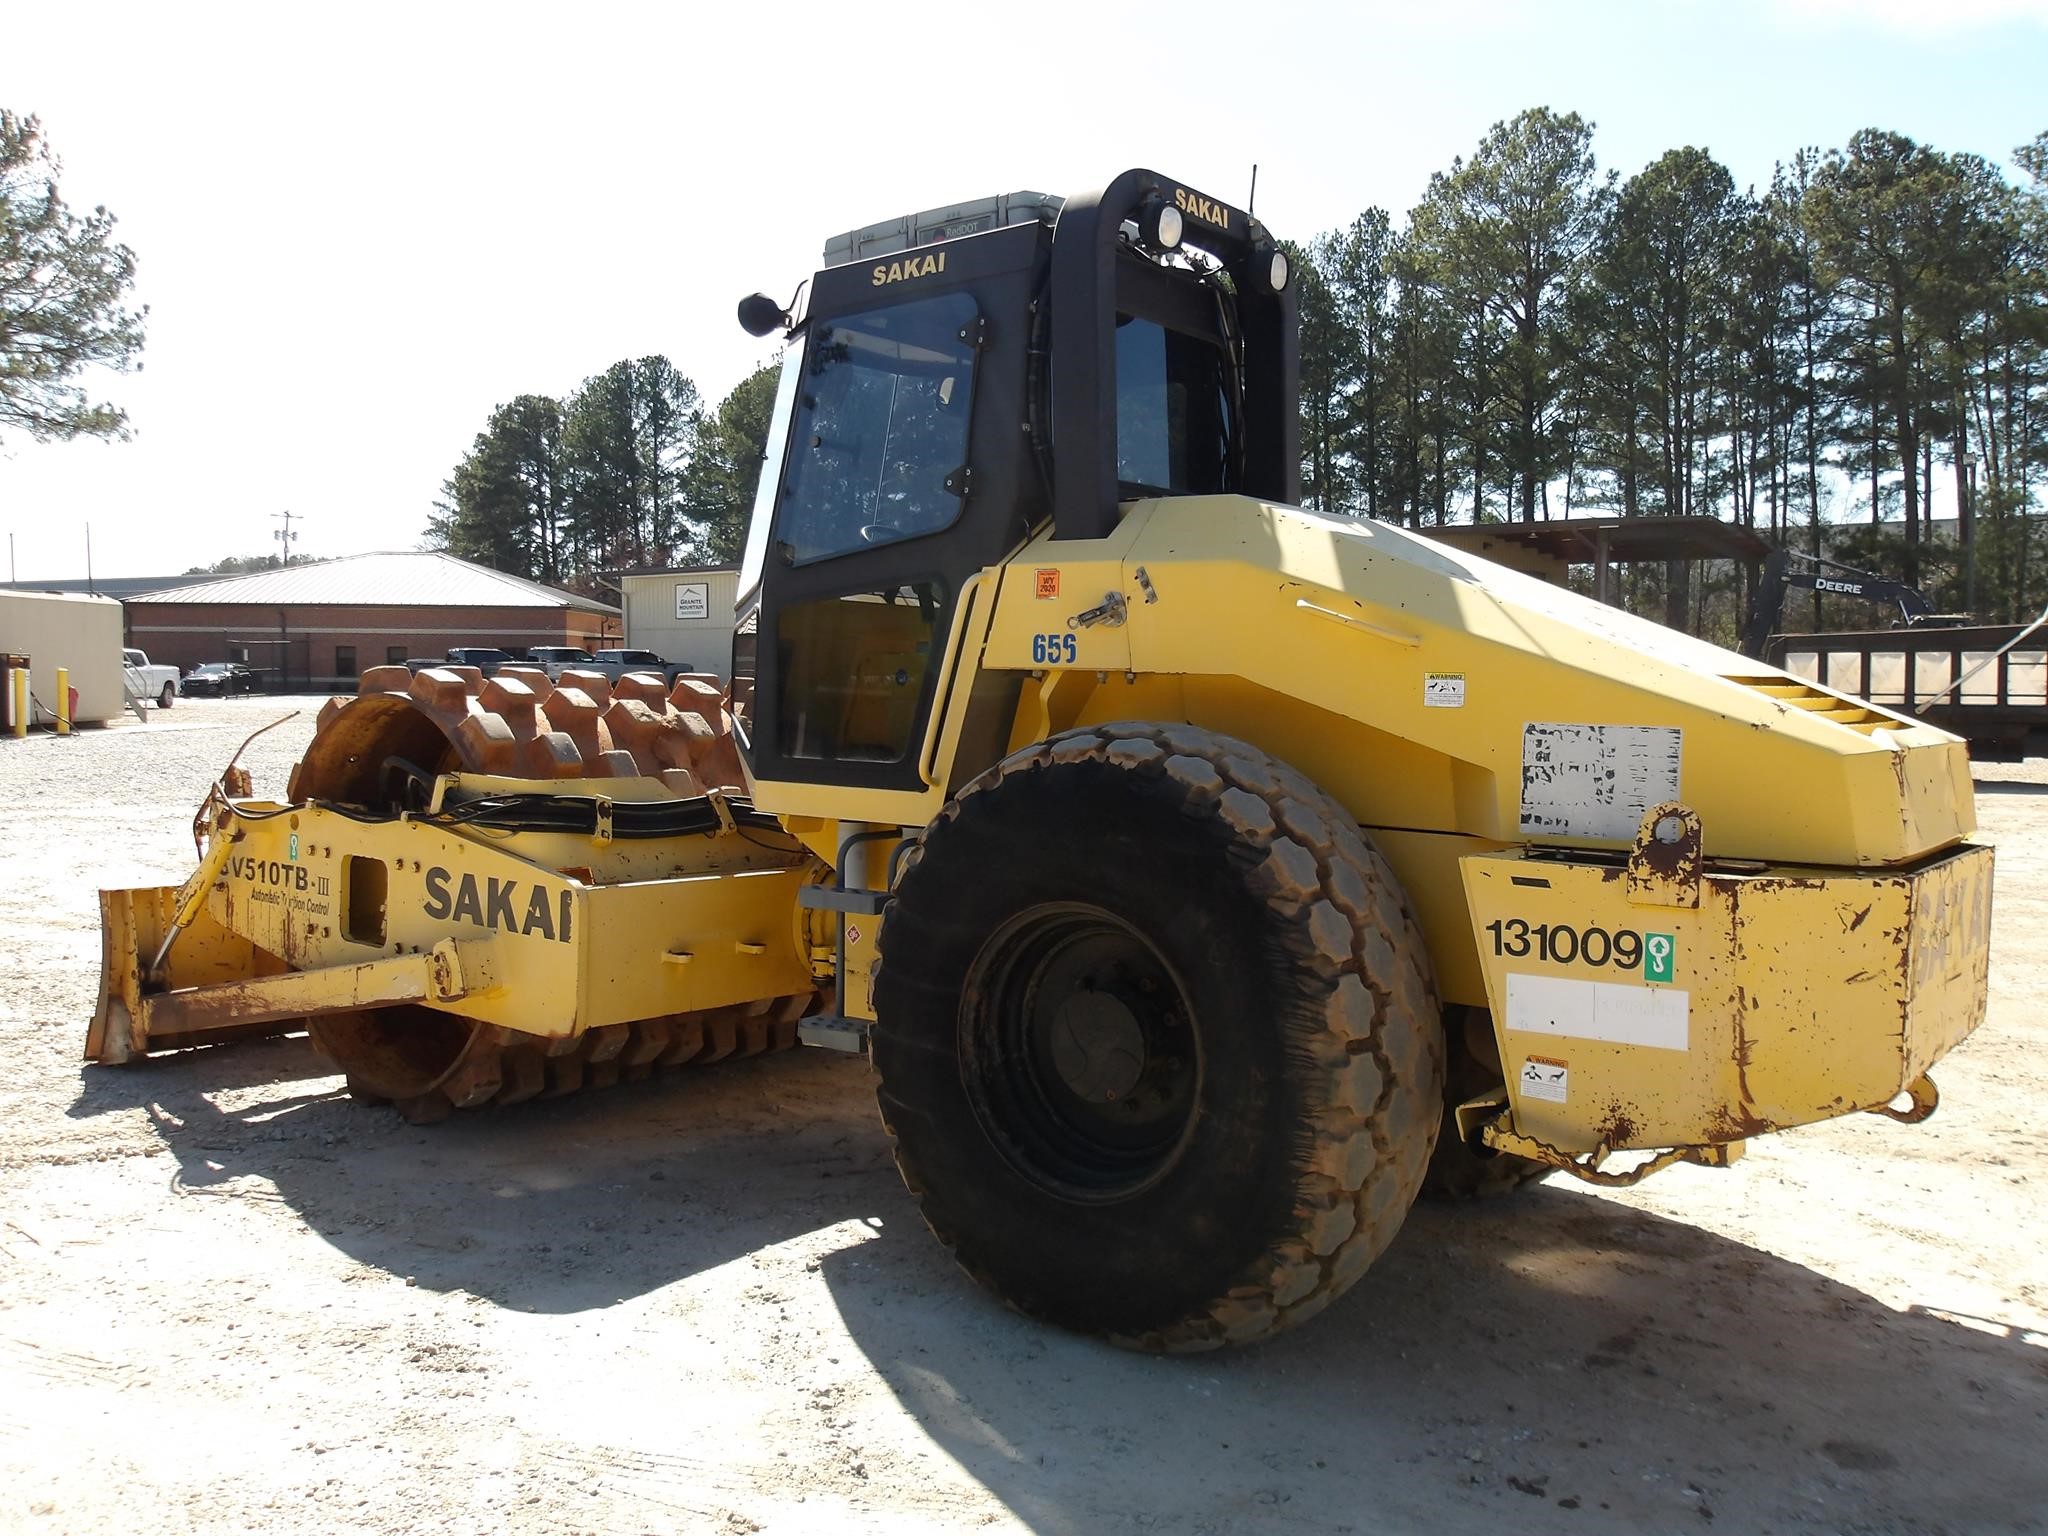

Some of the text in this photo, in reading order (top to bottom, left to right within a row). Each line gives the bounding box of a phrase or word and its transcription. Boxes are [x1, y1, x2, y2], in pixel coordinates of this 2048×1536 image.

[1175, 188, 1228, 229] SAKAI
[872, 252, 945, 286] SAKAI
[1815, 578, 1862, 594] DEERE
[306, 898, 330, 916] Control
[423, 866, 572, 943] SAKAI
[1485, 918, 1643, 970] 131009
[1535, 1057, 1565, 1068] WARNING
